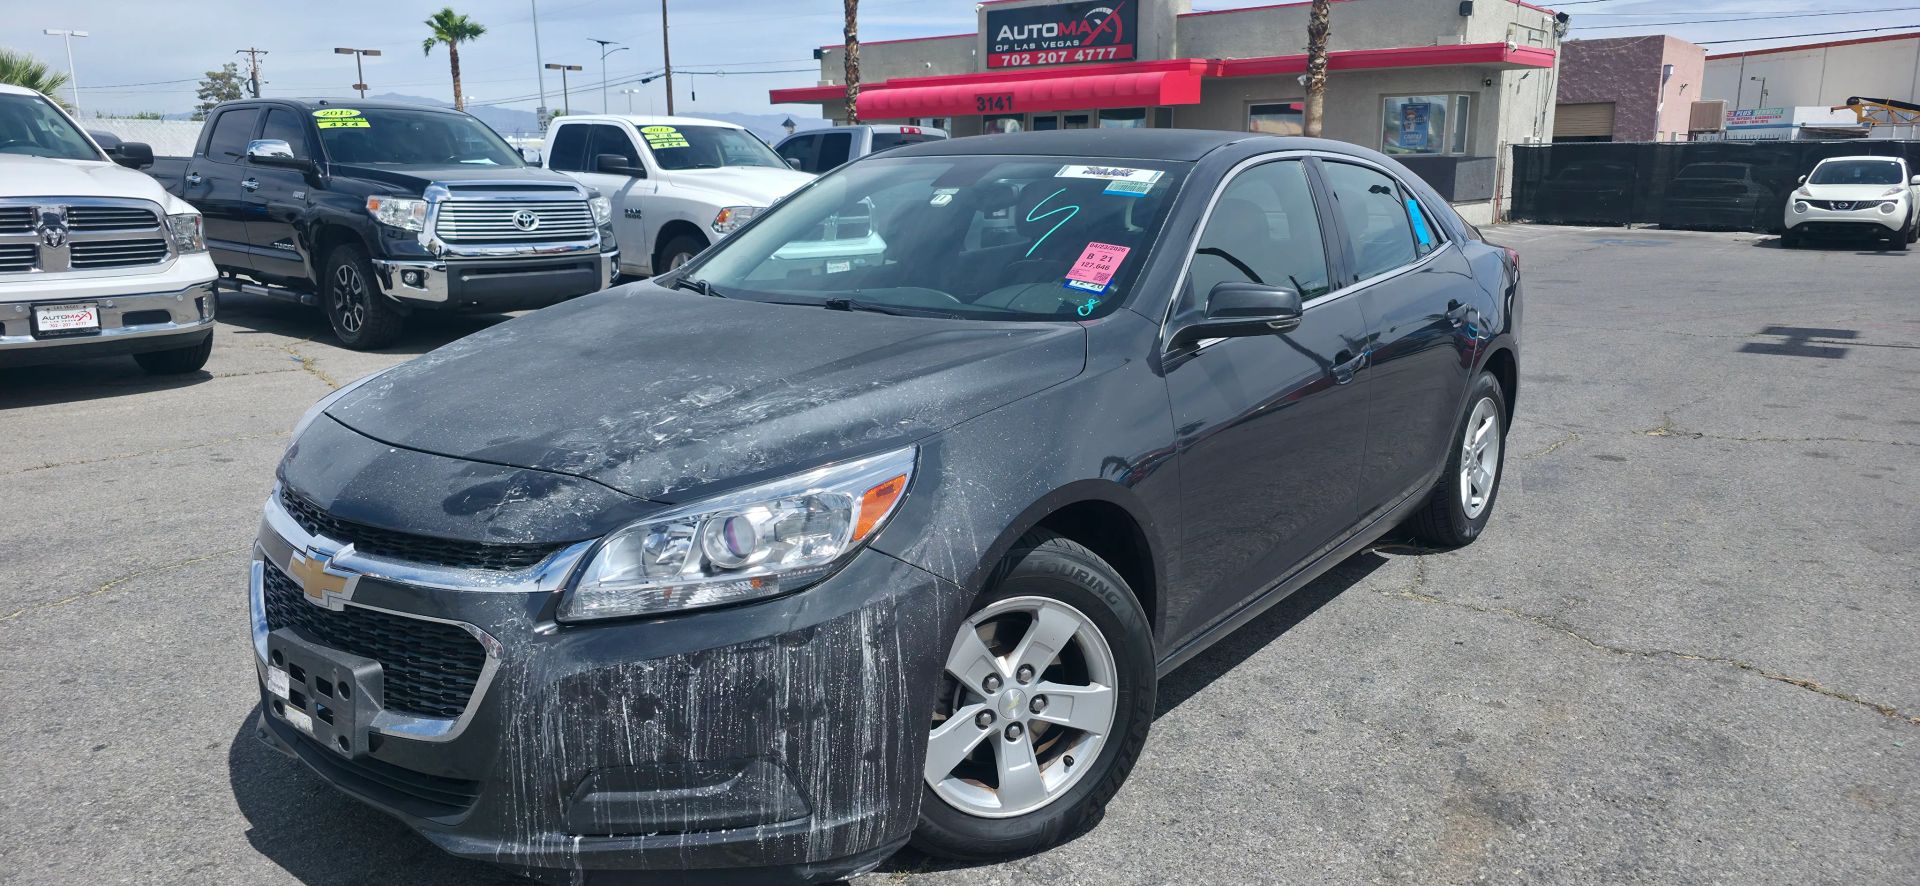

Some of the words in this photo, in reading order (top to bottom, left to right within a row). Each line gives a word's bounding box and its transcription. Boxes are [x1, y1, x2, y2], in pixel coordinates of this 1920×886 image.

[997, 4, 1121, 45] AUTOMAX
[995, 44, 1009, 52] OF
[1014, 42, 1036, 51] LAS
[1041, 39, 1080, 48] VEGAS
[1001, 54, 1031, 67] 702
[1037, 51, 1068, 64] 207
[1074, 47, 1117, 61] 4777
[976, 95, 1013, 112] 3141
[539, 121, 547, 131] 35
[1086, 252, 1095, 260] B
[1100, 254, 1113, 263] 21
[42, 310, 93, 321] AUTOMAX
[1030, 560, 1121, 606] TOURING
